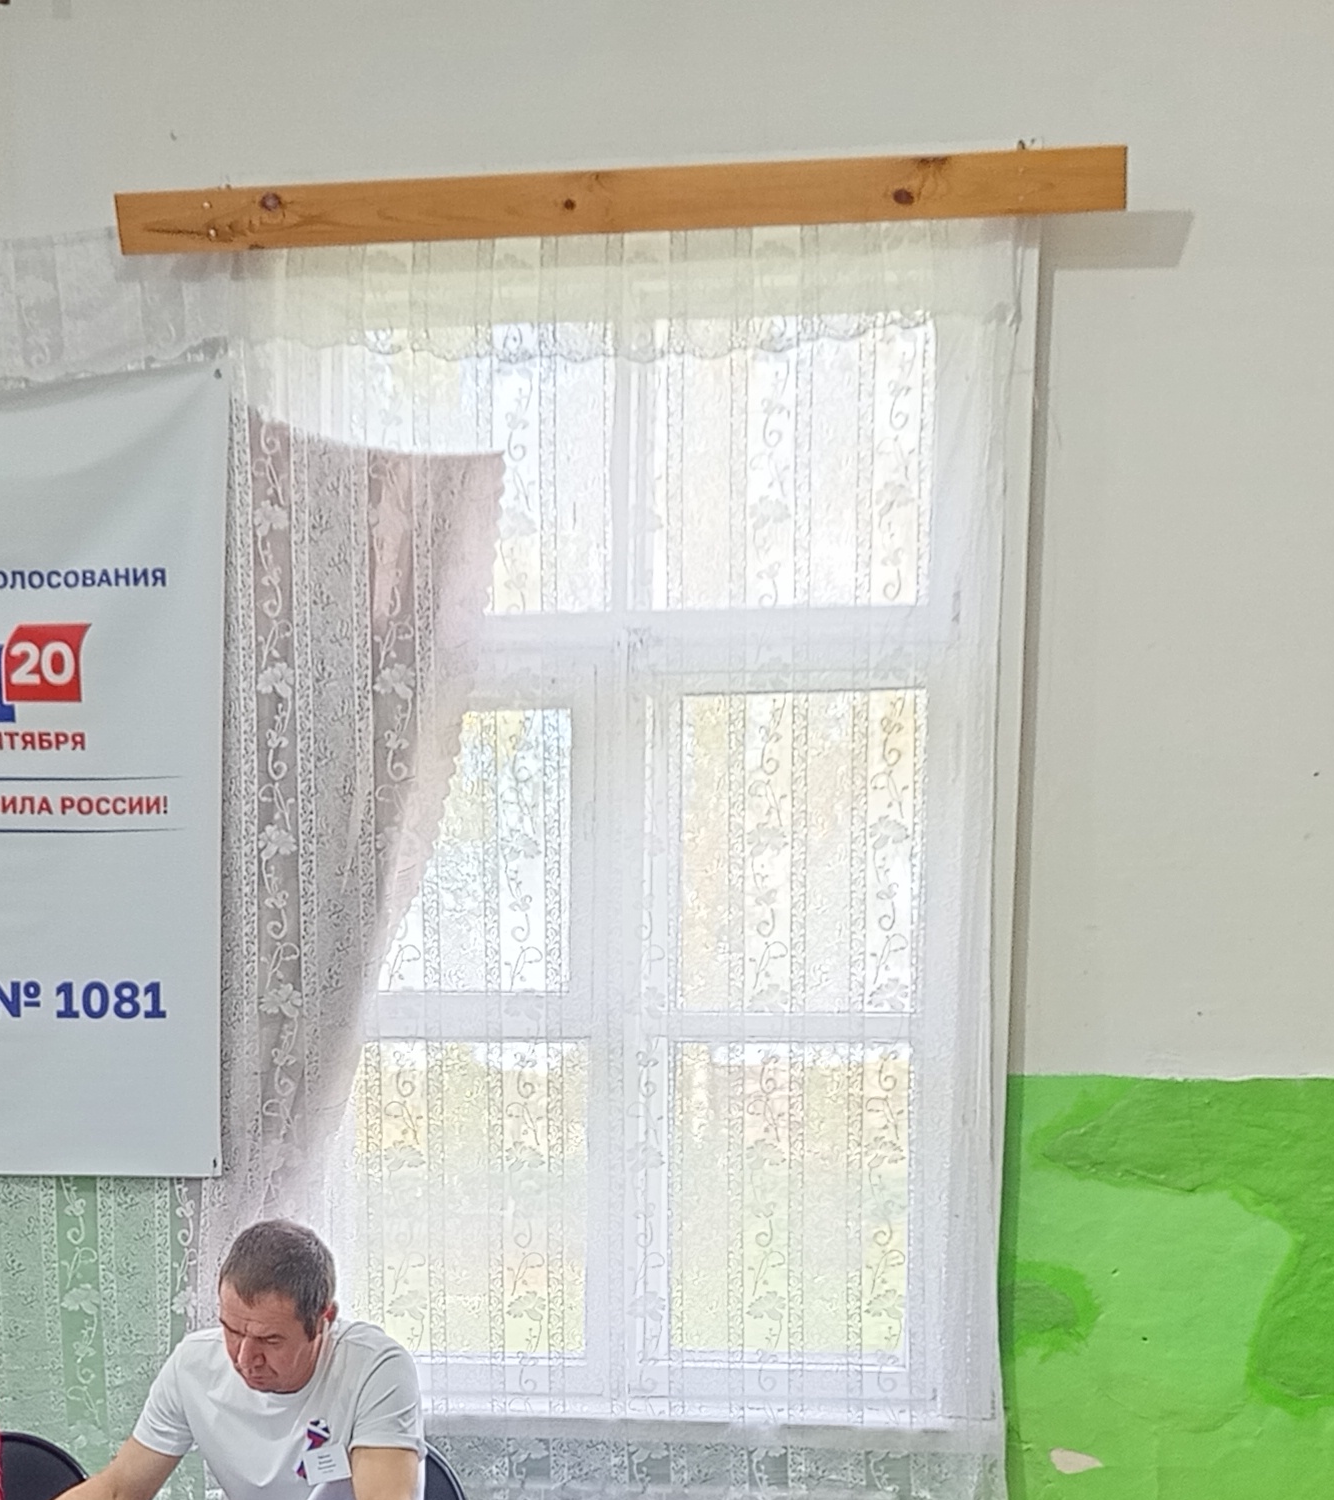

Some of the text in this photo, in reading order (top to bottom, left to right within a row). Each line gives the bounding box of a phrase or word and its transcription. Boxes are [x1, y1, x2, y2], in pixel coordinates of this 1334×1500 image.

[9, 641, 76, 686] 20
[60, 795, 168, 816] РОССИИ!
[55, 980, 167, 1020] 1081
